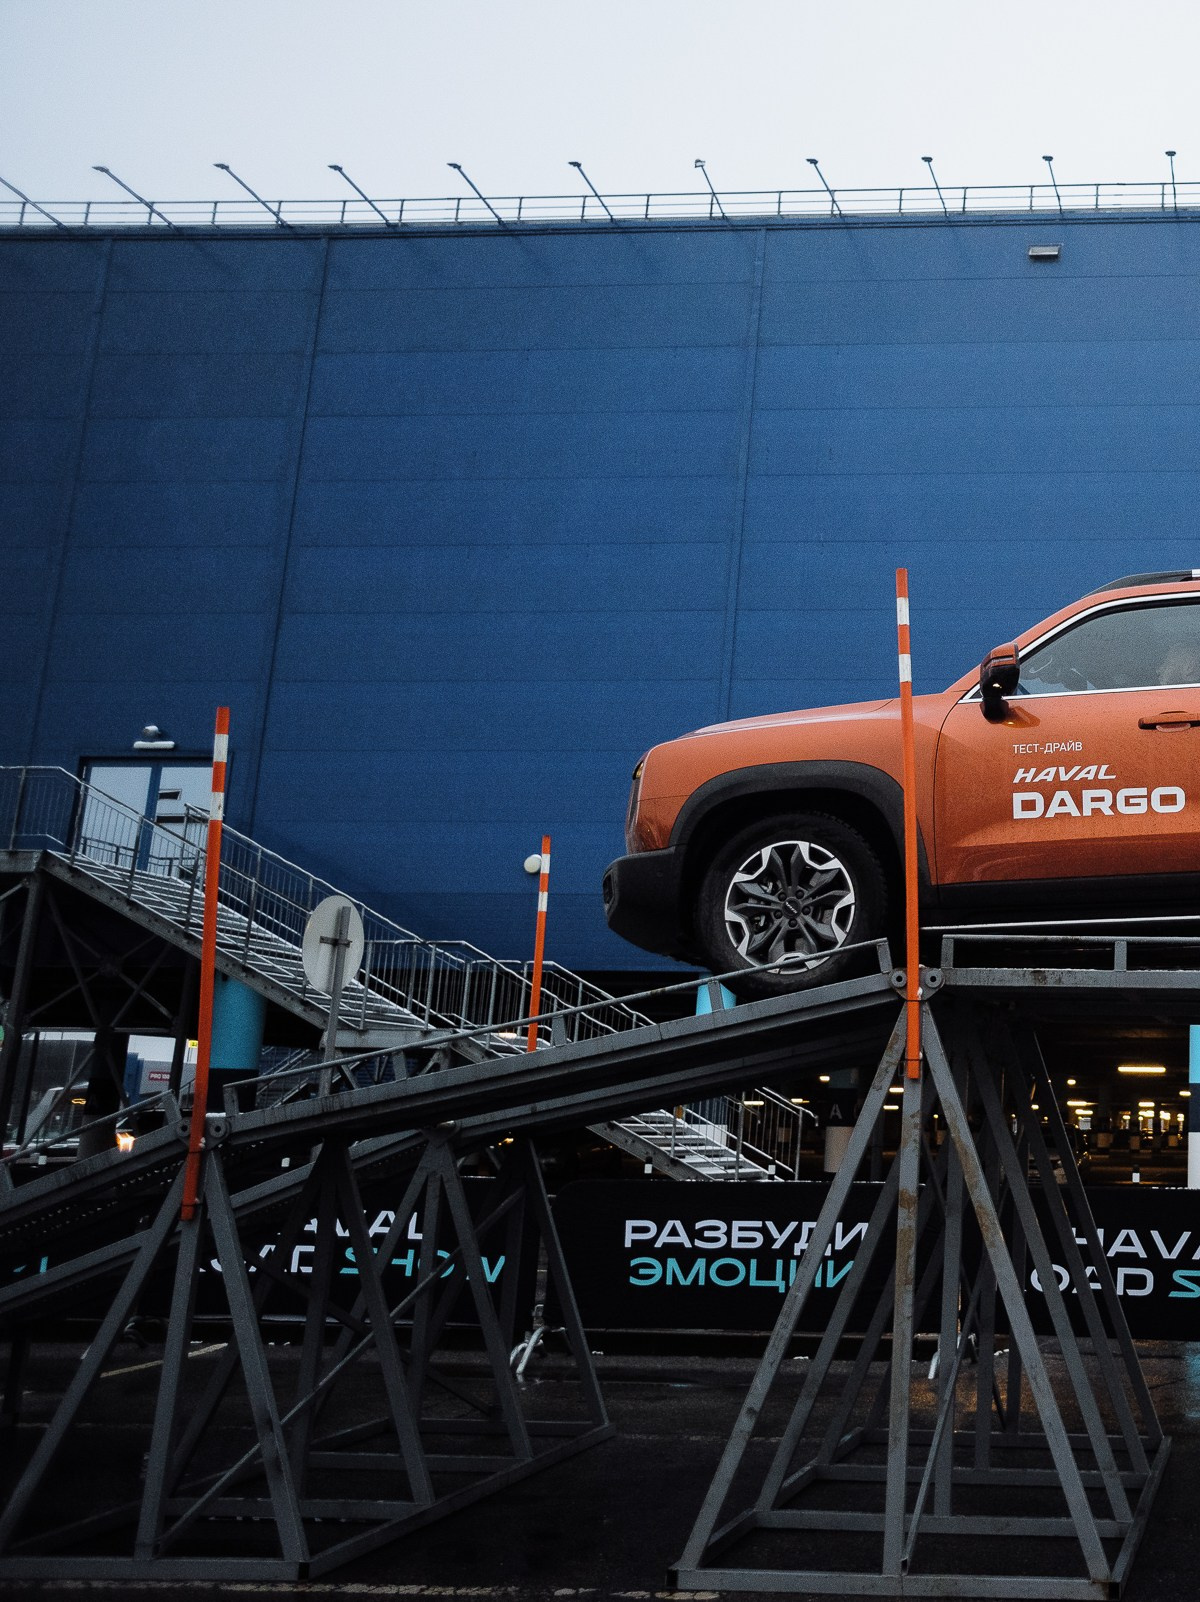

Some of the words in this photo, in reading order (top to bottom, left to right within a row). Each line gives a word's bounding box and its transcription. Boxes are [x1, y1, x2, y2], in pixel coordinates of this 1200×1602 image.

[1012, 740, 1083, 754] ТЕСТ-ДРАЙВ
[1012, 764, 1117, 783] HAVAL
[1012, 786, 1186, 819] DARGO
